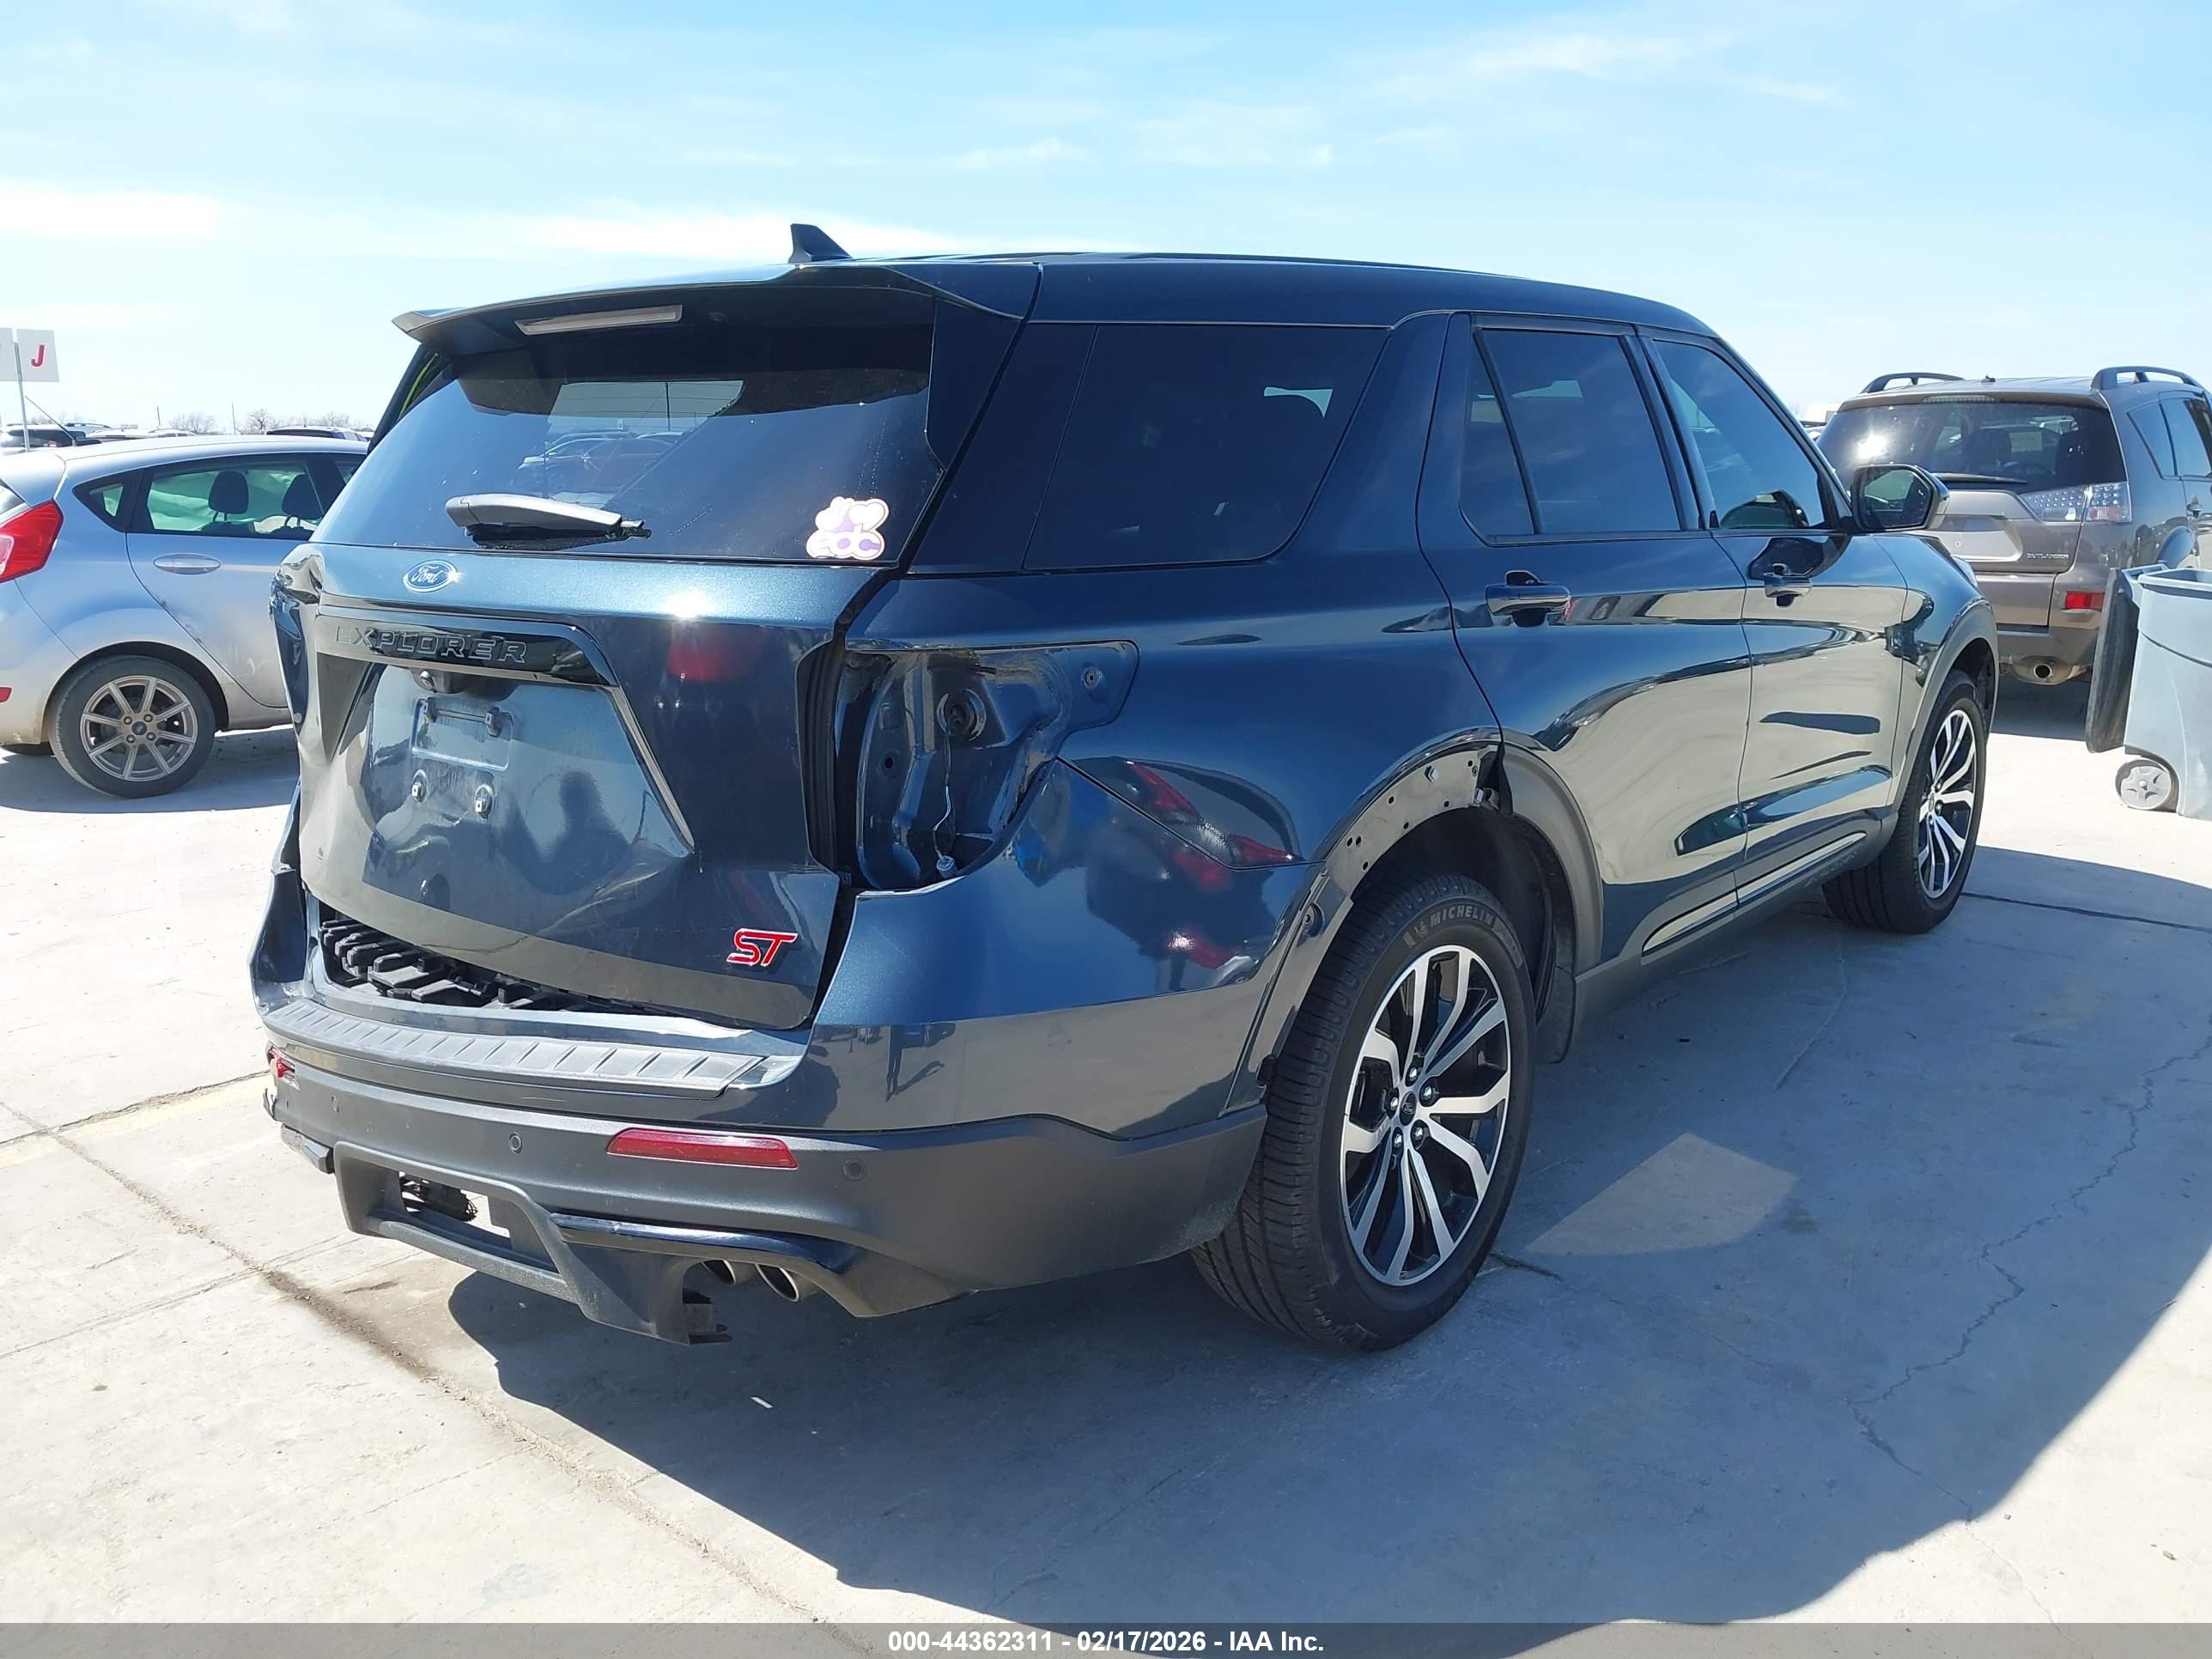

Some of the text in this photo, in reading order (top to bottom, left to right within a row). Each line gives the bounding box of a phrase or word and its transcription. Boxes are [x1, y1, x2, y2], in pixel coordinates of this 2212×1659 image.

[31, 344, 45, 368] J
[411, 565, 443, 584] Ford
[336, 624, 527, 663] EXPLORER
[1430, 905, 1494, 928] MICHELIN
[726, 928, 799, 967] ST
